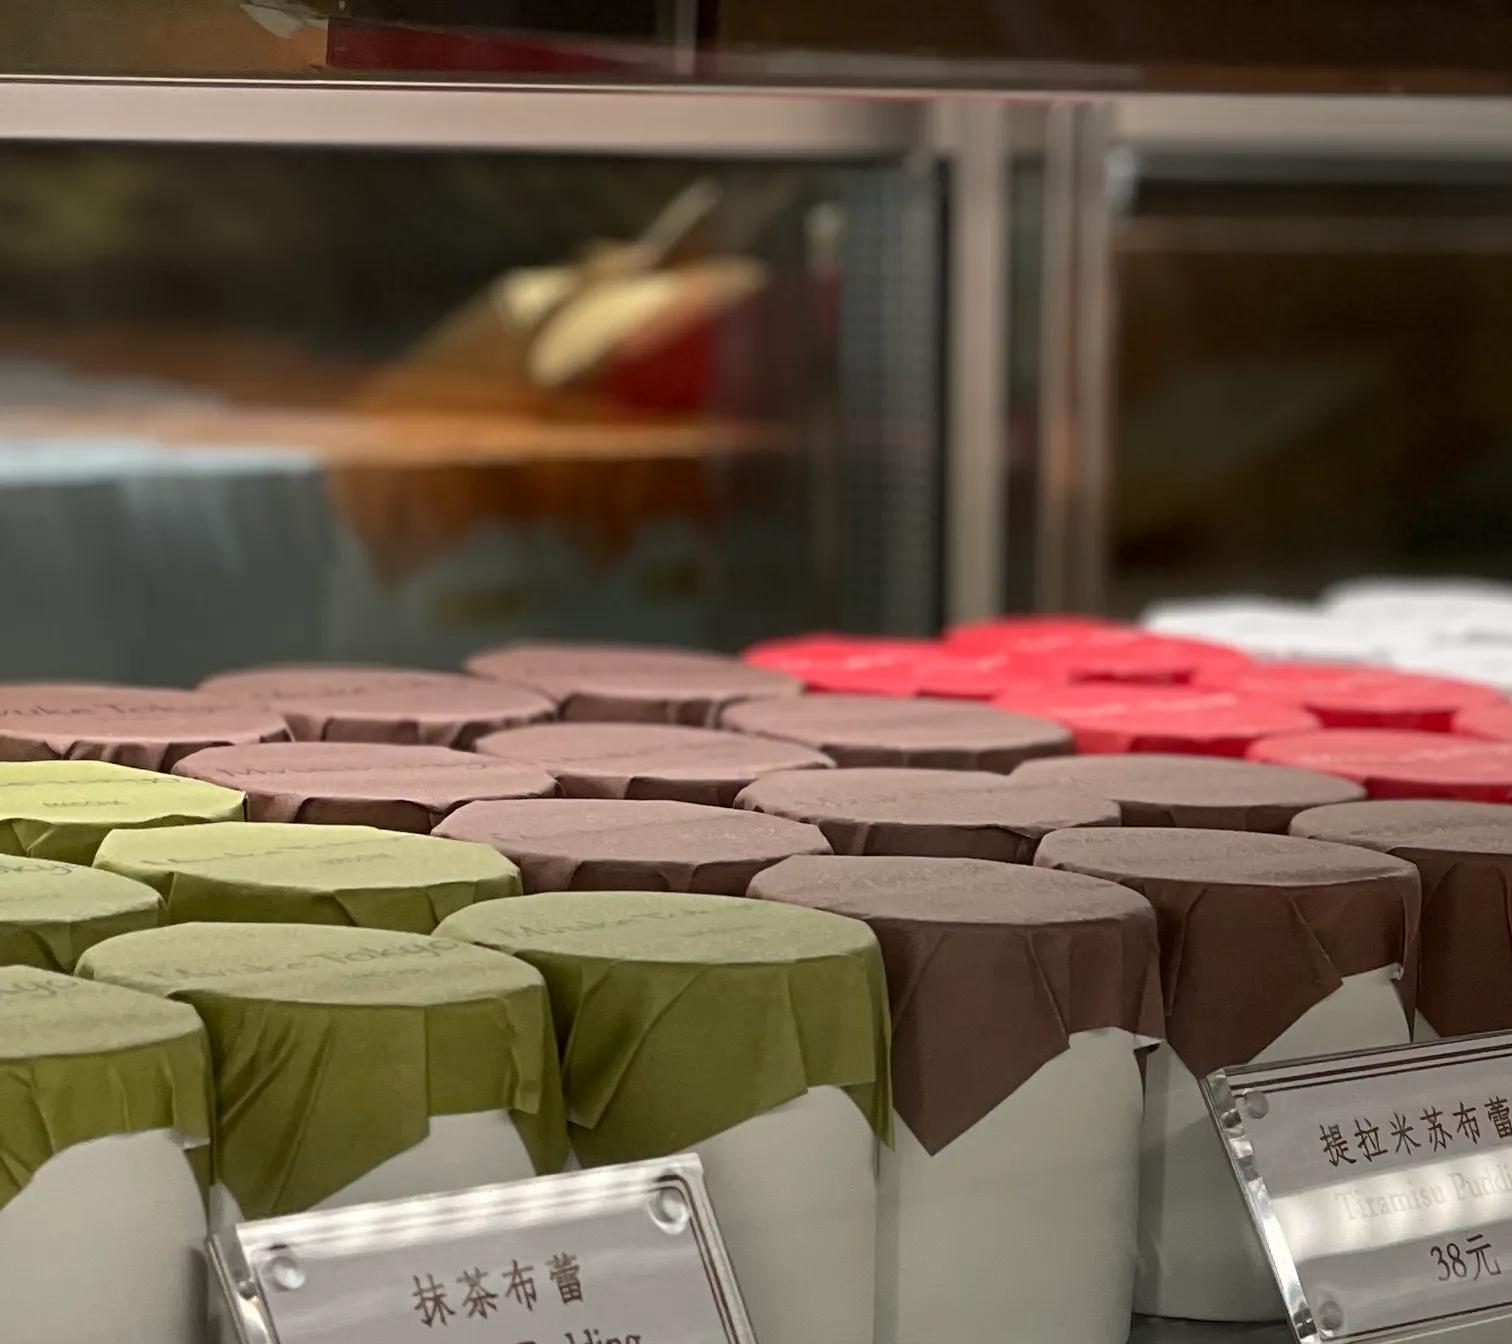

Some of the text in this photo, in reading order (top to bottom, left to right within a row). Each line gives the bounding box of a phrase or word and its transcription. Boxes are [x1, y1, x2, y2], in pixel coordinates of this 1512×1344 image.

[1335, 1182, 1445, 1221] Tiramisu
[1430, 1233, 1502, 1281] 38元
[412, 1252, 584, 1328] 抹茶布蕾
